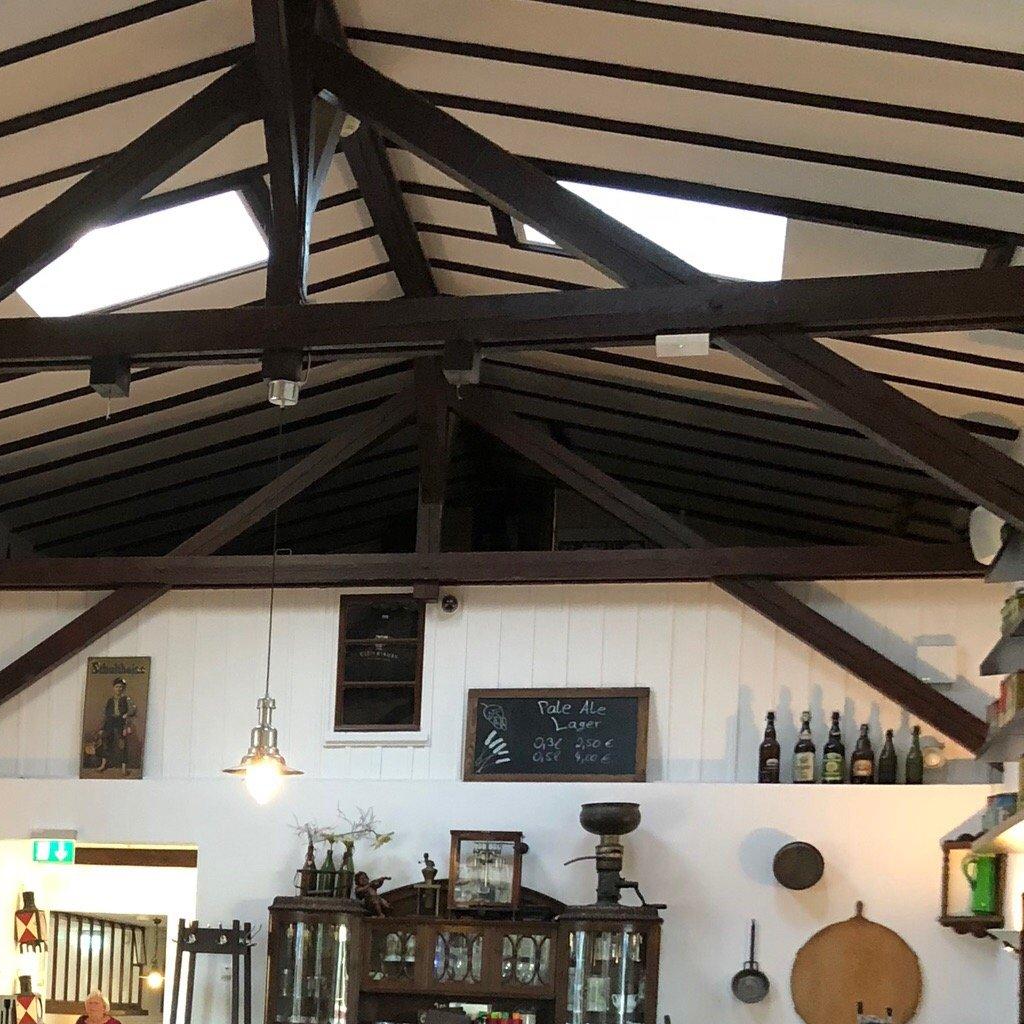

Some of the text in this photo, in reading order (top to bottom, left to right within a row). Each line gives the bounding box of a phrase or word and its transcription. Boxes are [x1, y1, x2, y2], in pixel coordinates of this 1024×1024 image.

[537, 699, 607, 716] Pale Ale
[550, 716, 602, 732] Lager
